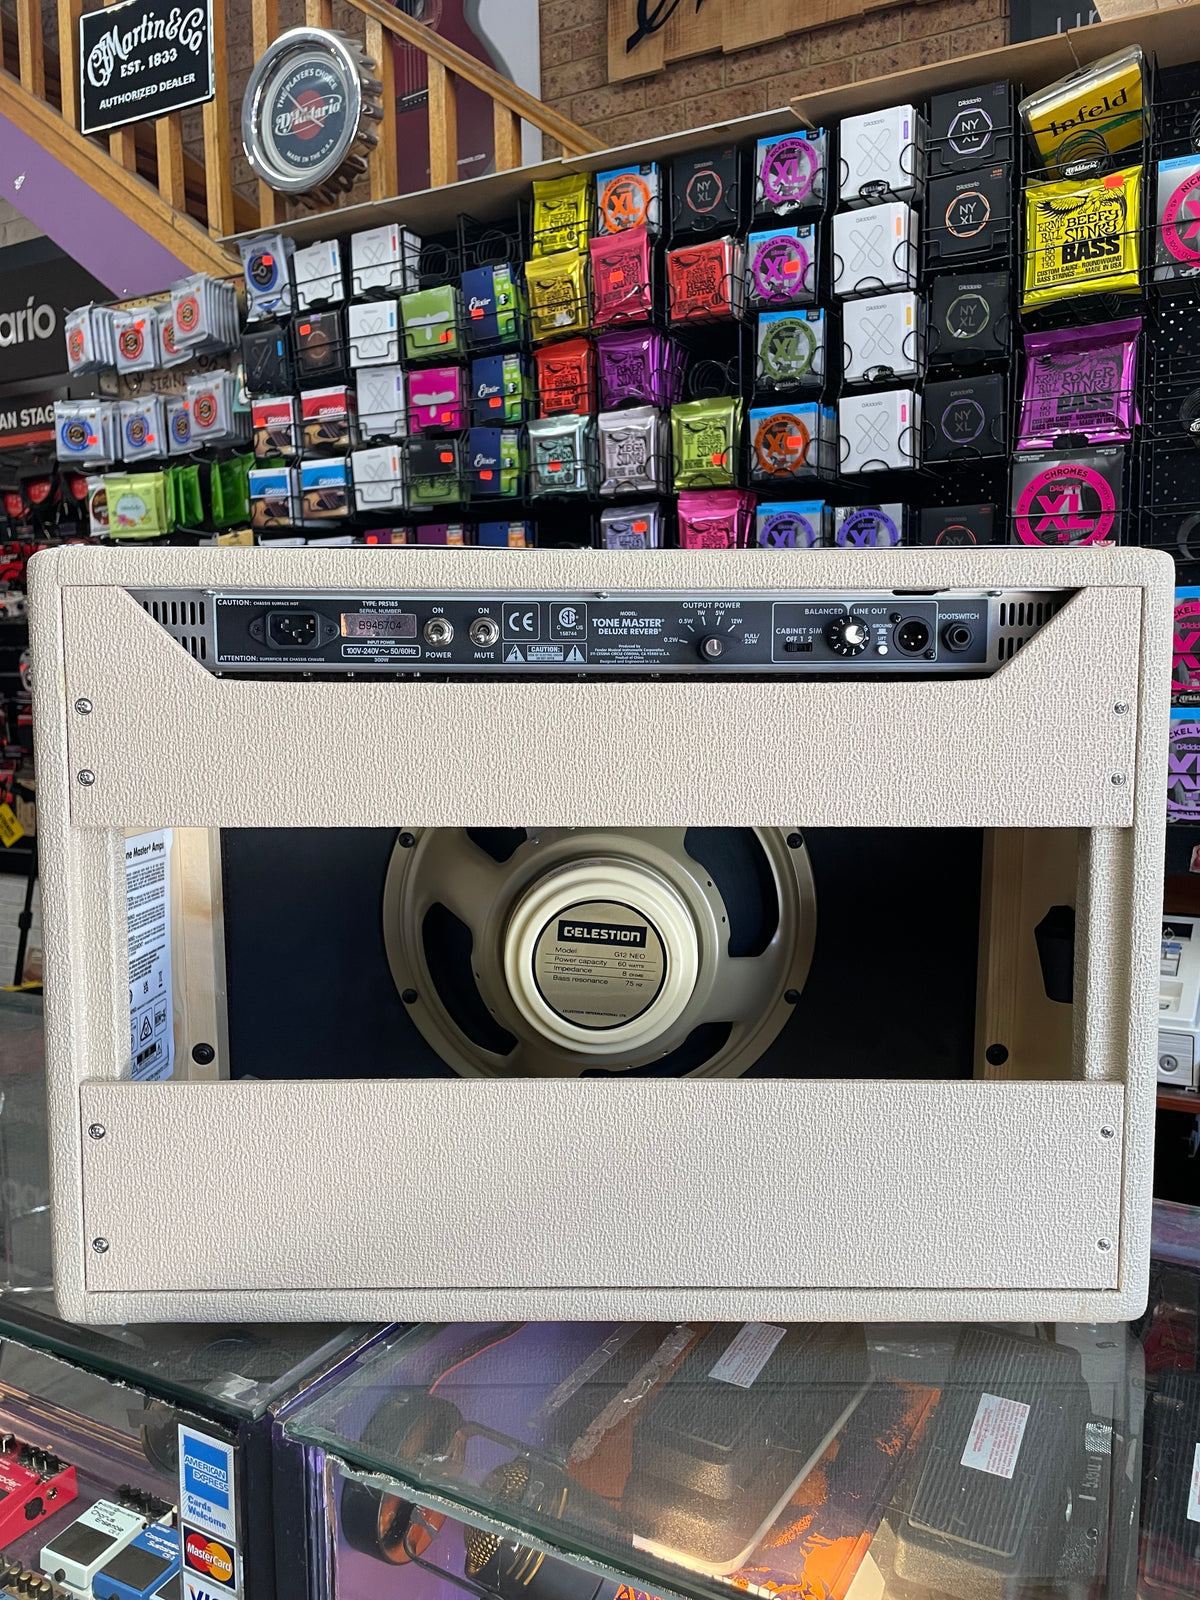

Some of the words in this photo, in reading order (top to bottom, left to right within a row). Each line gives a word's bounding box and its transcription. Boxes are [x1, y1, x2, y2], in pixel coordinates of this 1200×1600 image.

[120, 60, 146, 78] EST.
[148, 47, 178, 69] 1833
[99, 84, 158, 110] AUTHORIZED
[159, 73, 196, 93] DEALER
[1048, 87, 1128, 137] Infeld
[961, 118, 979, 132] NY
[773, 158, 806, 187] XL
[696, 180, 711, 192] NY
[610, 191, 640, 219] XL
[697, 192, 712, 202] XL
[959, 202, 977, 215] NY
[1066, 209, 1119, 228] BEEFY
[1063, 220, 1117, 244] SLINKY
[1061, 234, 1120, 265] BASS
[1037, 267, 1060, 277] CUSTOM
[960, 304, 977, 316] NY
[959, 316, 976, 327] XL
[772, 337, 805, 363] XL
[1063, 366, 1115, 382] POWER
[1060, 377, 1113, 396] SLINKY
[954, 409, 971, 422] NY
[955, 420, 972, 432] XL
[1044, 467, 1088, 480] CHROMES
[1034, 493, 1095, 532] XL
[508, 612, 533, 632] CE
[592, 618, 620, 627] TONE
[775, 627, 807, 635] CABINET
[808, 627, 823, 635] SIM
[390, 647, 417, 655] 50/60Hz
[563, 926, 641, 943] CELESTION
[555, 946, 578, 954] Model
[614, 951, 628, 960] G12
[553, 964, 593, 974] Impedance
[554, 956, 577, 964] Power
[578, 958, 608, 967] capacity
[552, 974, 571, 982] Bass
[571, 977, 609, 985] resonance
[184, 1454, 226, 1482] AMERICAN
[192, 1471, 229, 1493] EXPRESS
[187, 1495, 212, 1513] Cards
[187, 1504, 227, 1530] Welcome
[187, 1541, 233, 1573] MasterCard
